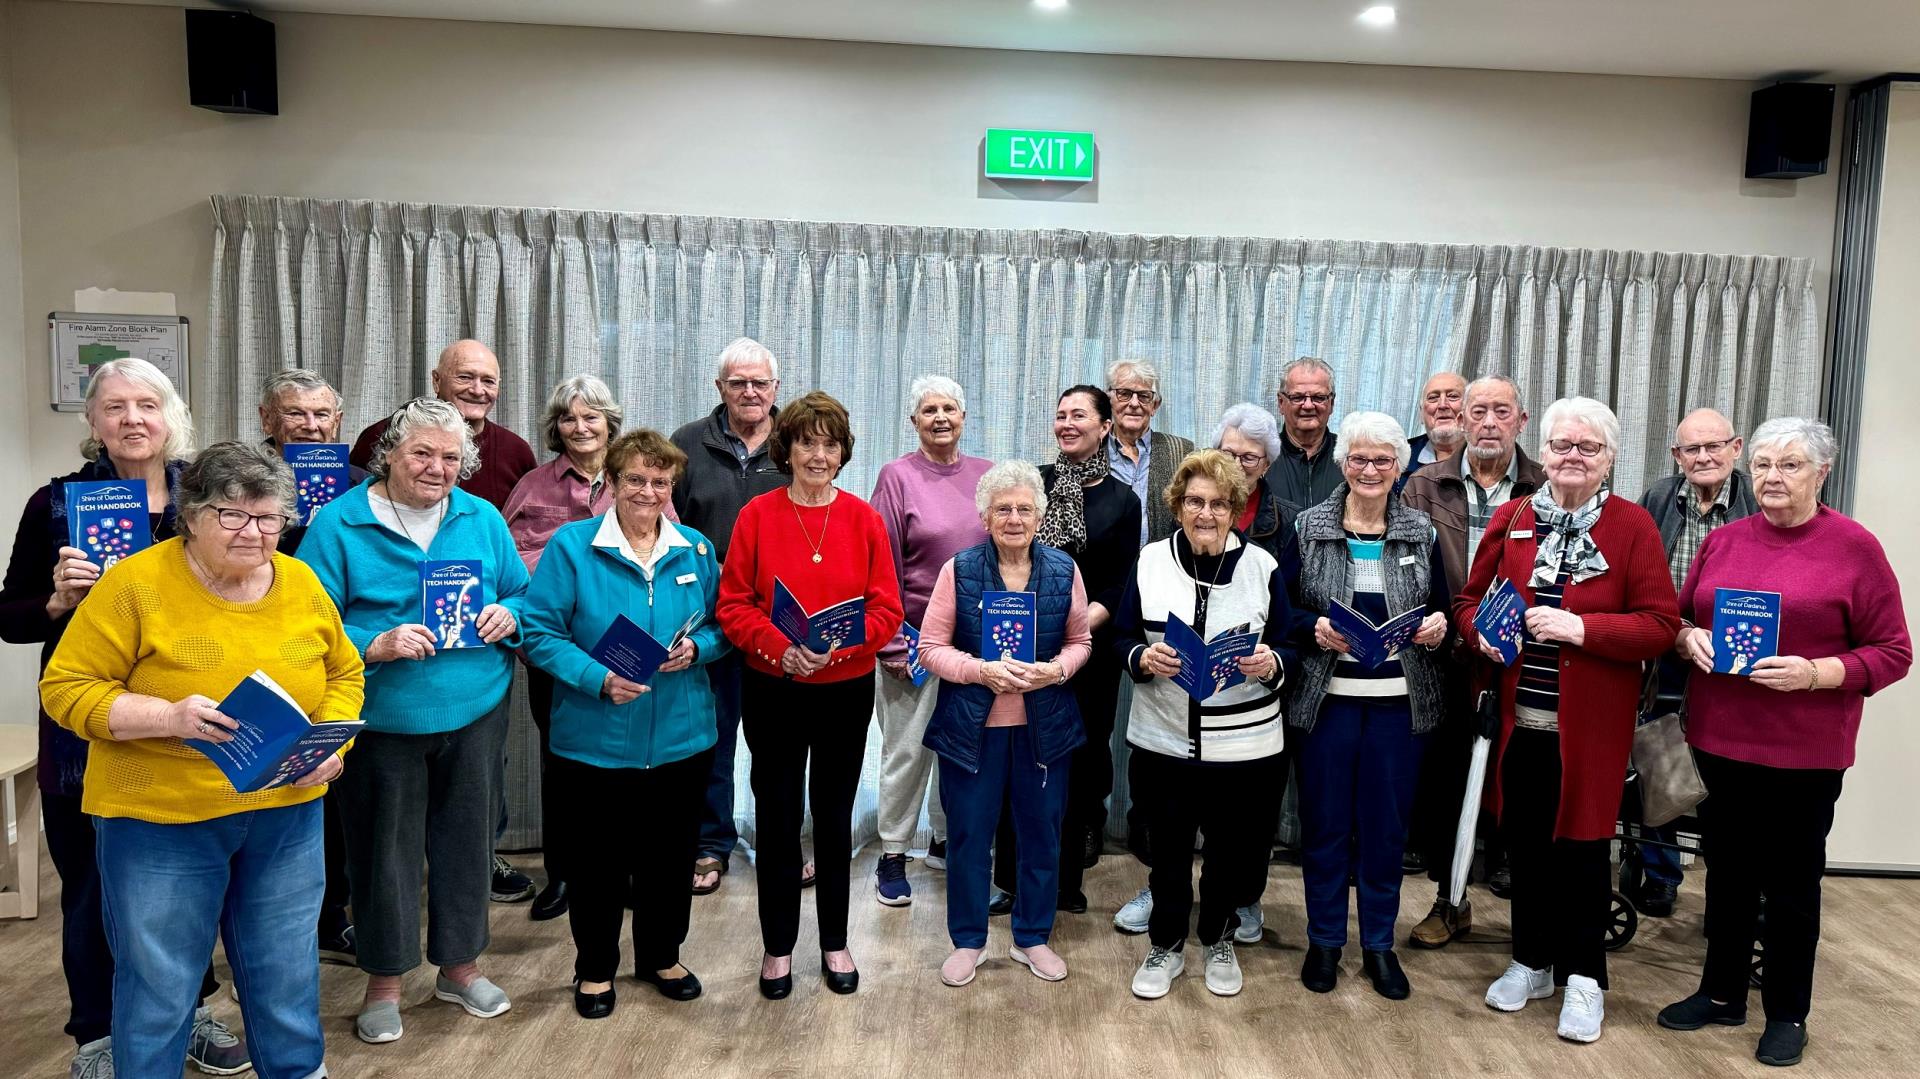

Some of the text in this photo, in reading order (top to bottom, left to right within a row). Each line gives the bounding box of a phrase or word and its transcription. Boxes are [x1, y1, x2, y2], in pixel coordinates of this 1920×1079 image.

[1010, 136, 1070, 170] EXIT
[68, 323, 83, 332] Fire
[84, 324, 106, 332] Alarm
[108, 324, 127, 333] Zone
[128, 325, 149, 333] Block
[97, 502, 142, 511] HANDBOOK
[1743, 602, 1767, 610] Dardanup
[1720, 607, 1773, 618] TECH HANDBOOK
